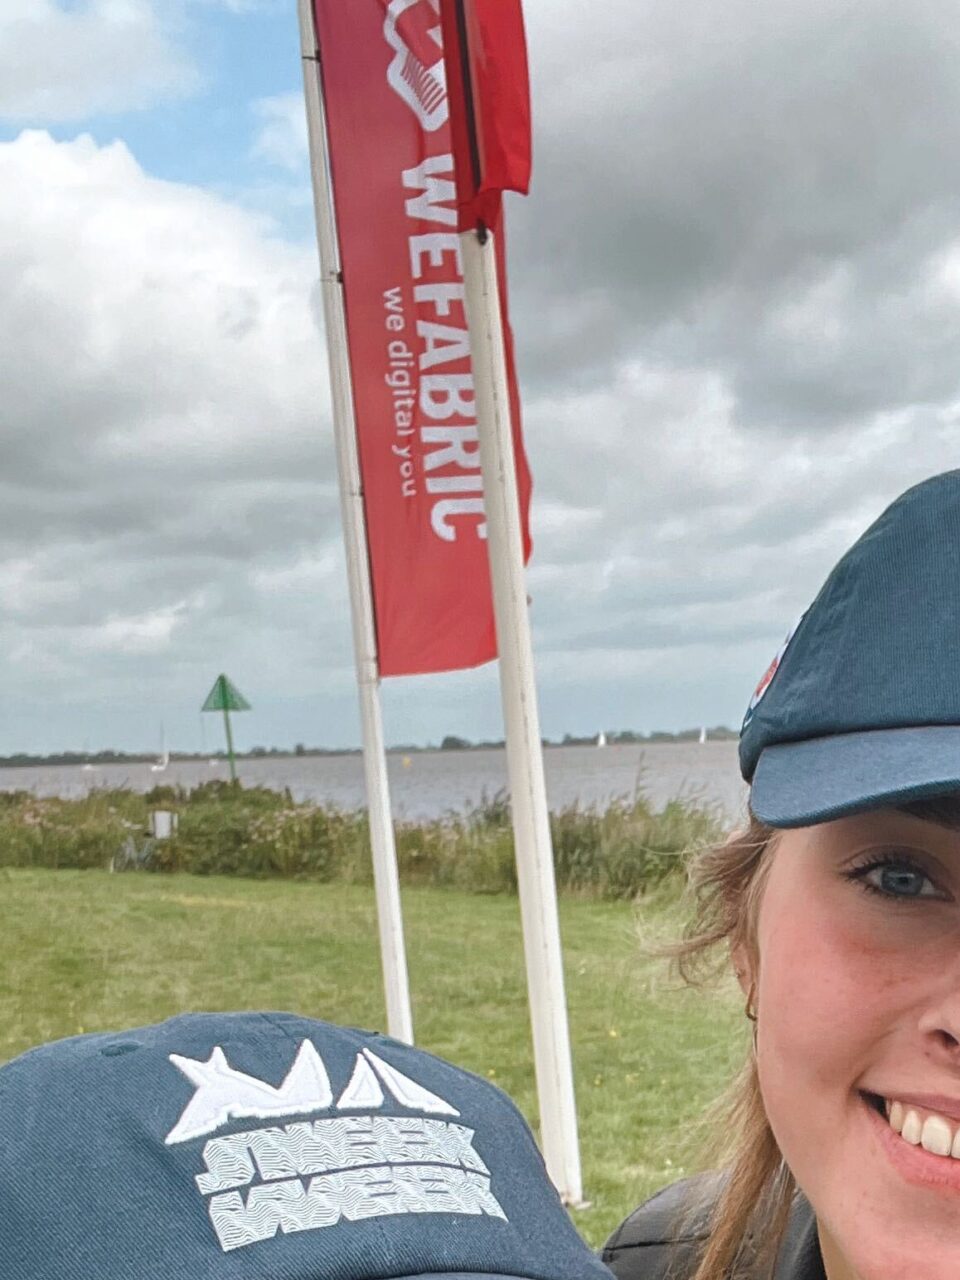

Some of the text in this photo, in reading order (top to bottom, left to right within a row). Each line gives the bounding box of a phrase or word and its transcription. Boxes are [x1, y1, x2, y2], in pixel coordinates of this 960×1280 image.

[383, 286, 417, 497] we digital you
[401, 152, 488, 542] WEFABRIC
[195, 1115, 492, 1195] SNEEK
[208, 1165, 509, 1252] WEEK
